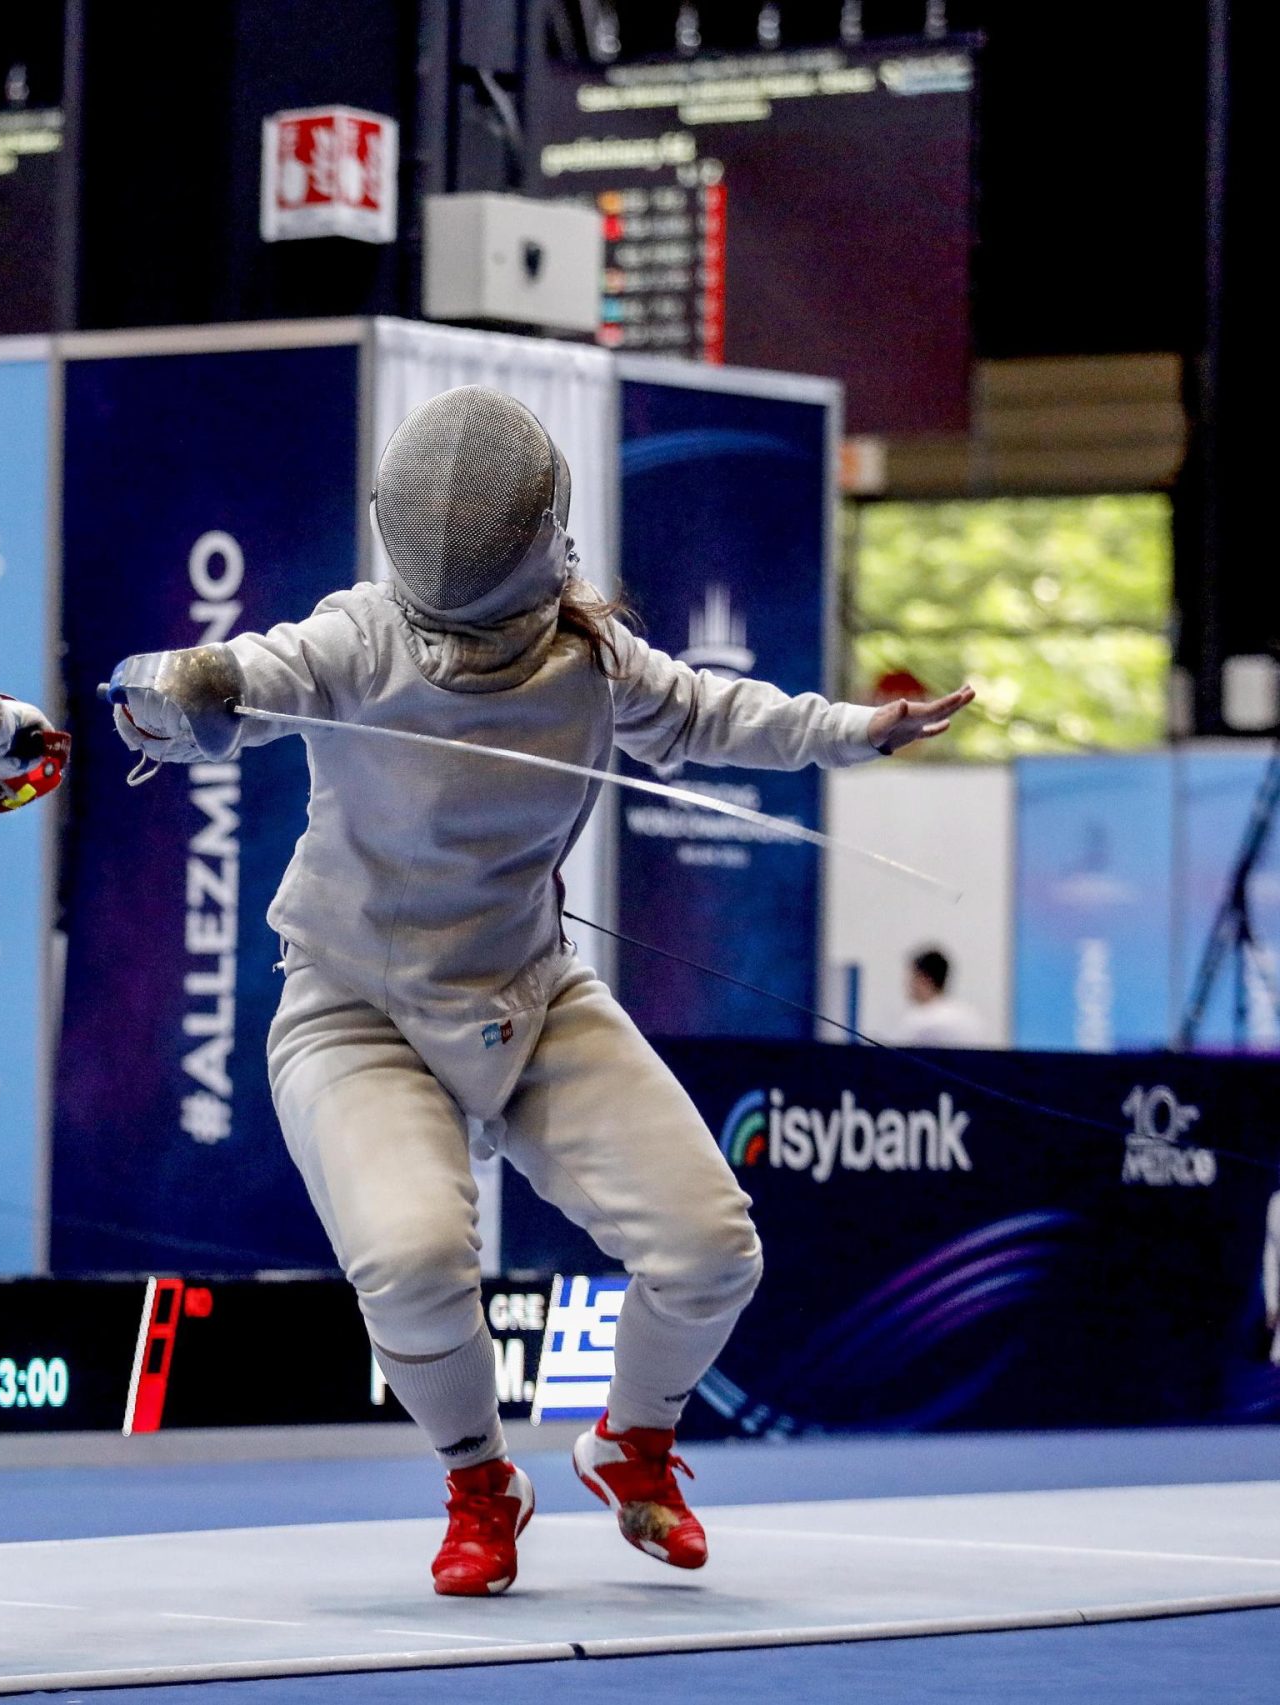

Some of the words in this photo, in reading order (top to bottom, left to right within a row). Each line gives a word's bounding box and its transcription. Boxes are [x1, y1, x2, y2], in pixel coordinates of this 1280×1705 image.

[179, 529, 245, 1146] #ALLEZMINO
[769, 1087, 972, 1184] isybank
[489, 1293, 546, 1331] GRE
